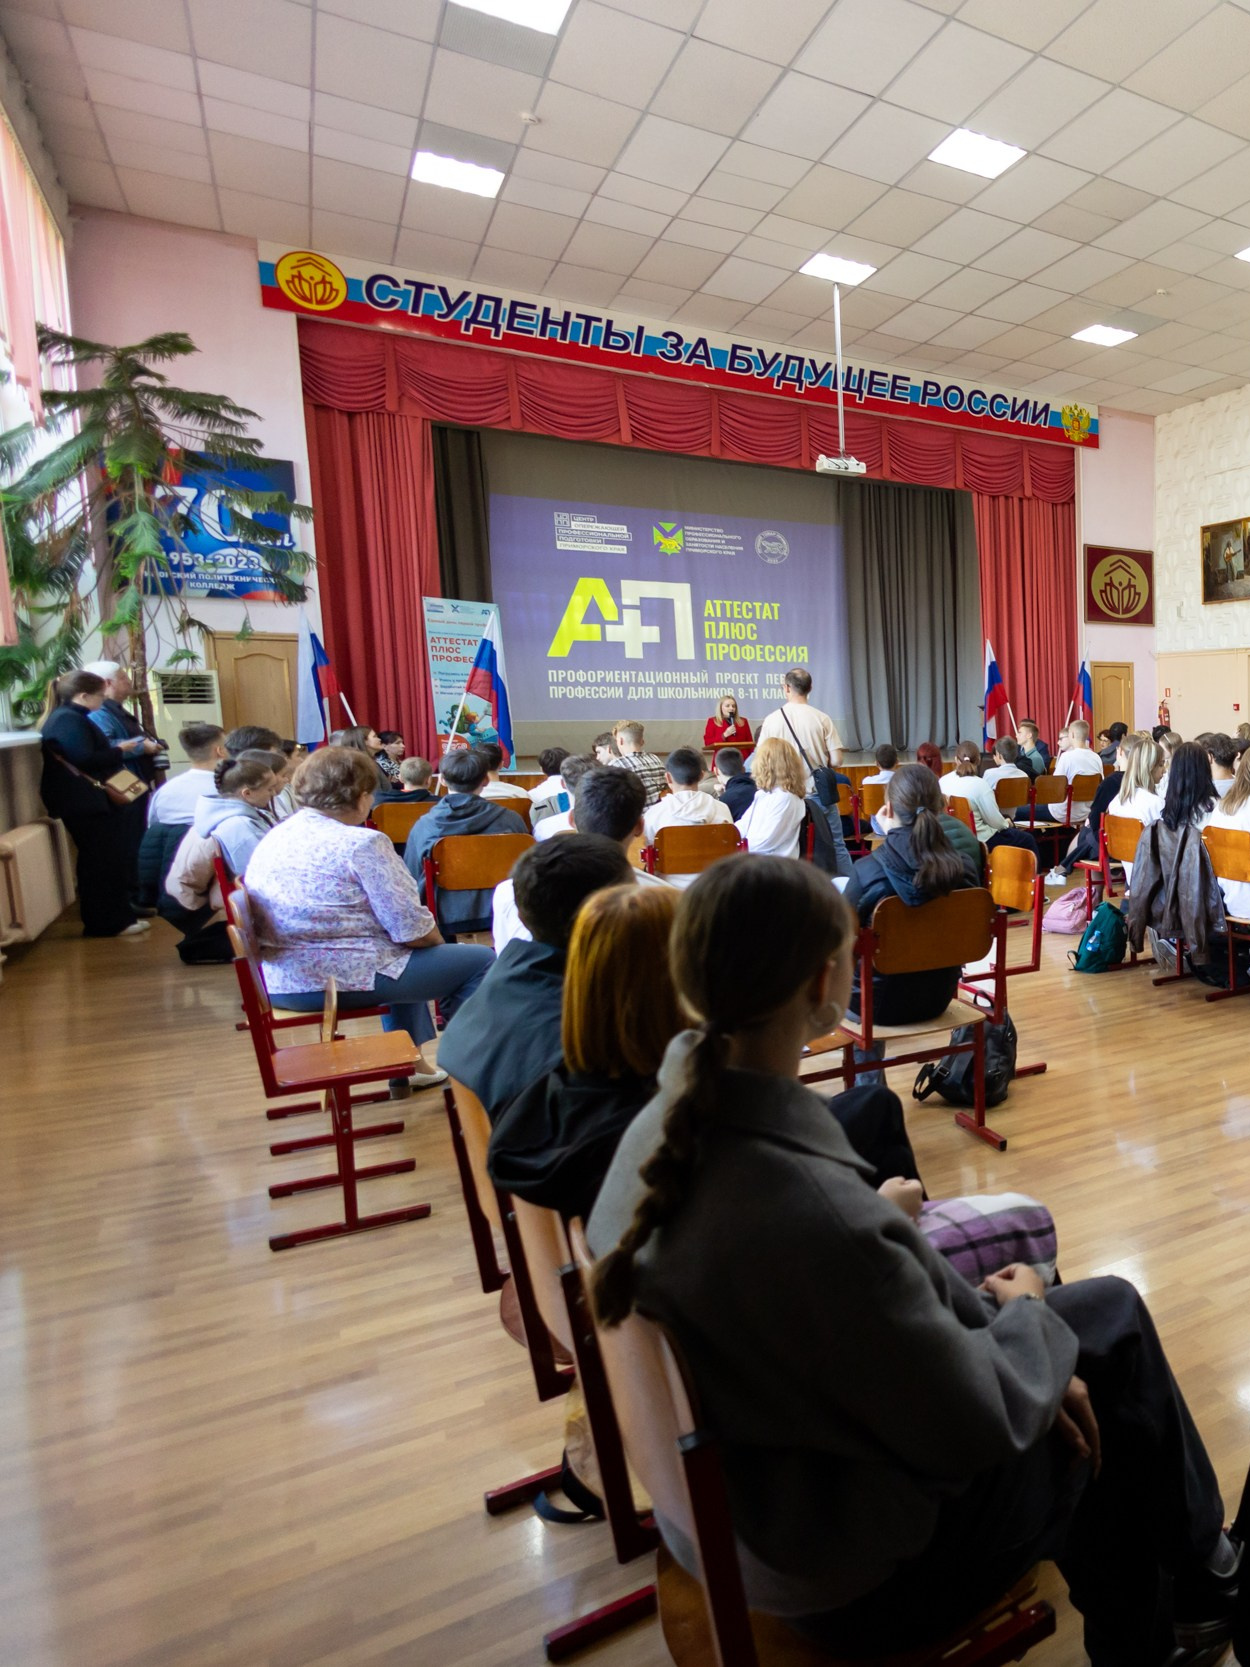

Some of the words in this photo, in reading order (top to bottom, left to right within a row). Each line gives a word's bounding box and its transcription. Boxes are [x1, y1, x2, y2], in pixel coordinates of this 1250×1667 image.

[363, 273, 645, 357] СТУДЕНТЫ
[656, 330, 715, 370] ЗА
[726, 343, 911, 403] БУДУЩЕЕ
[919, 380, 1051, 428] РОССИИ
[704, 599, 780, 620] АТТЕСТАТ
[704, 621, 758, 641] ПЛЮС
[430, 636, 479, 646] АТТЕСТАТ
[431, 645, 461, 654] ПЛЮС
[705, 643, 809, 663] ПРОФЕССИЯ
[548, 669, 709, 685] ПРОФОРИЕНТАЦИОННЫЙ
[715, 672, 760, 685] ПРОЕКТ
[549, 685, 624, 699] ПРОФЕССИИ
[627, 686, 654, 700] ДЛЯ
[657, 686, 734, 699] ШКОЛЬНИКОВ
[738, 687, 759, 699] 8-11
